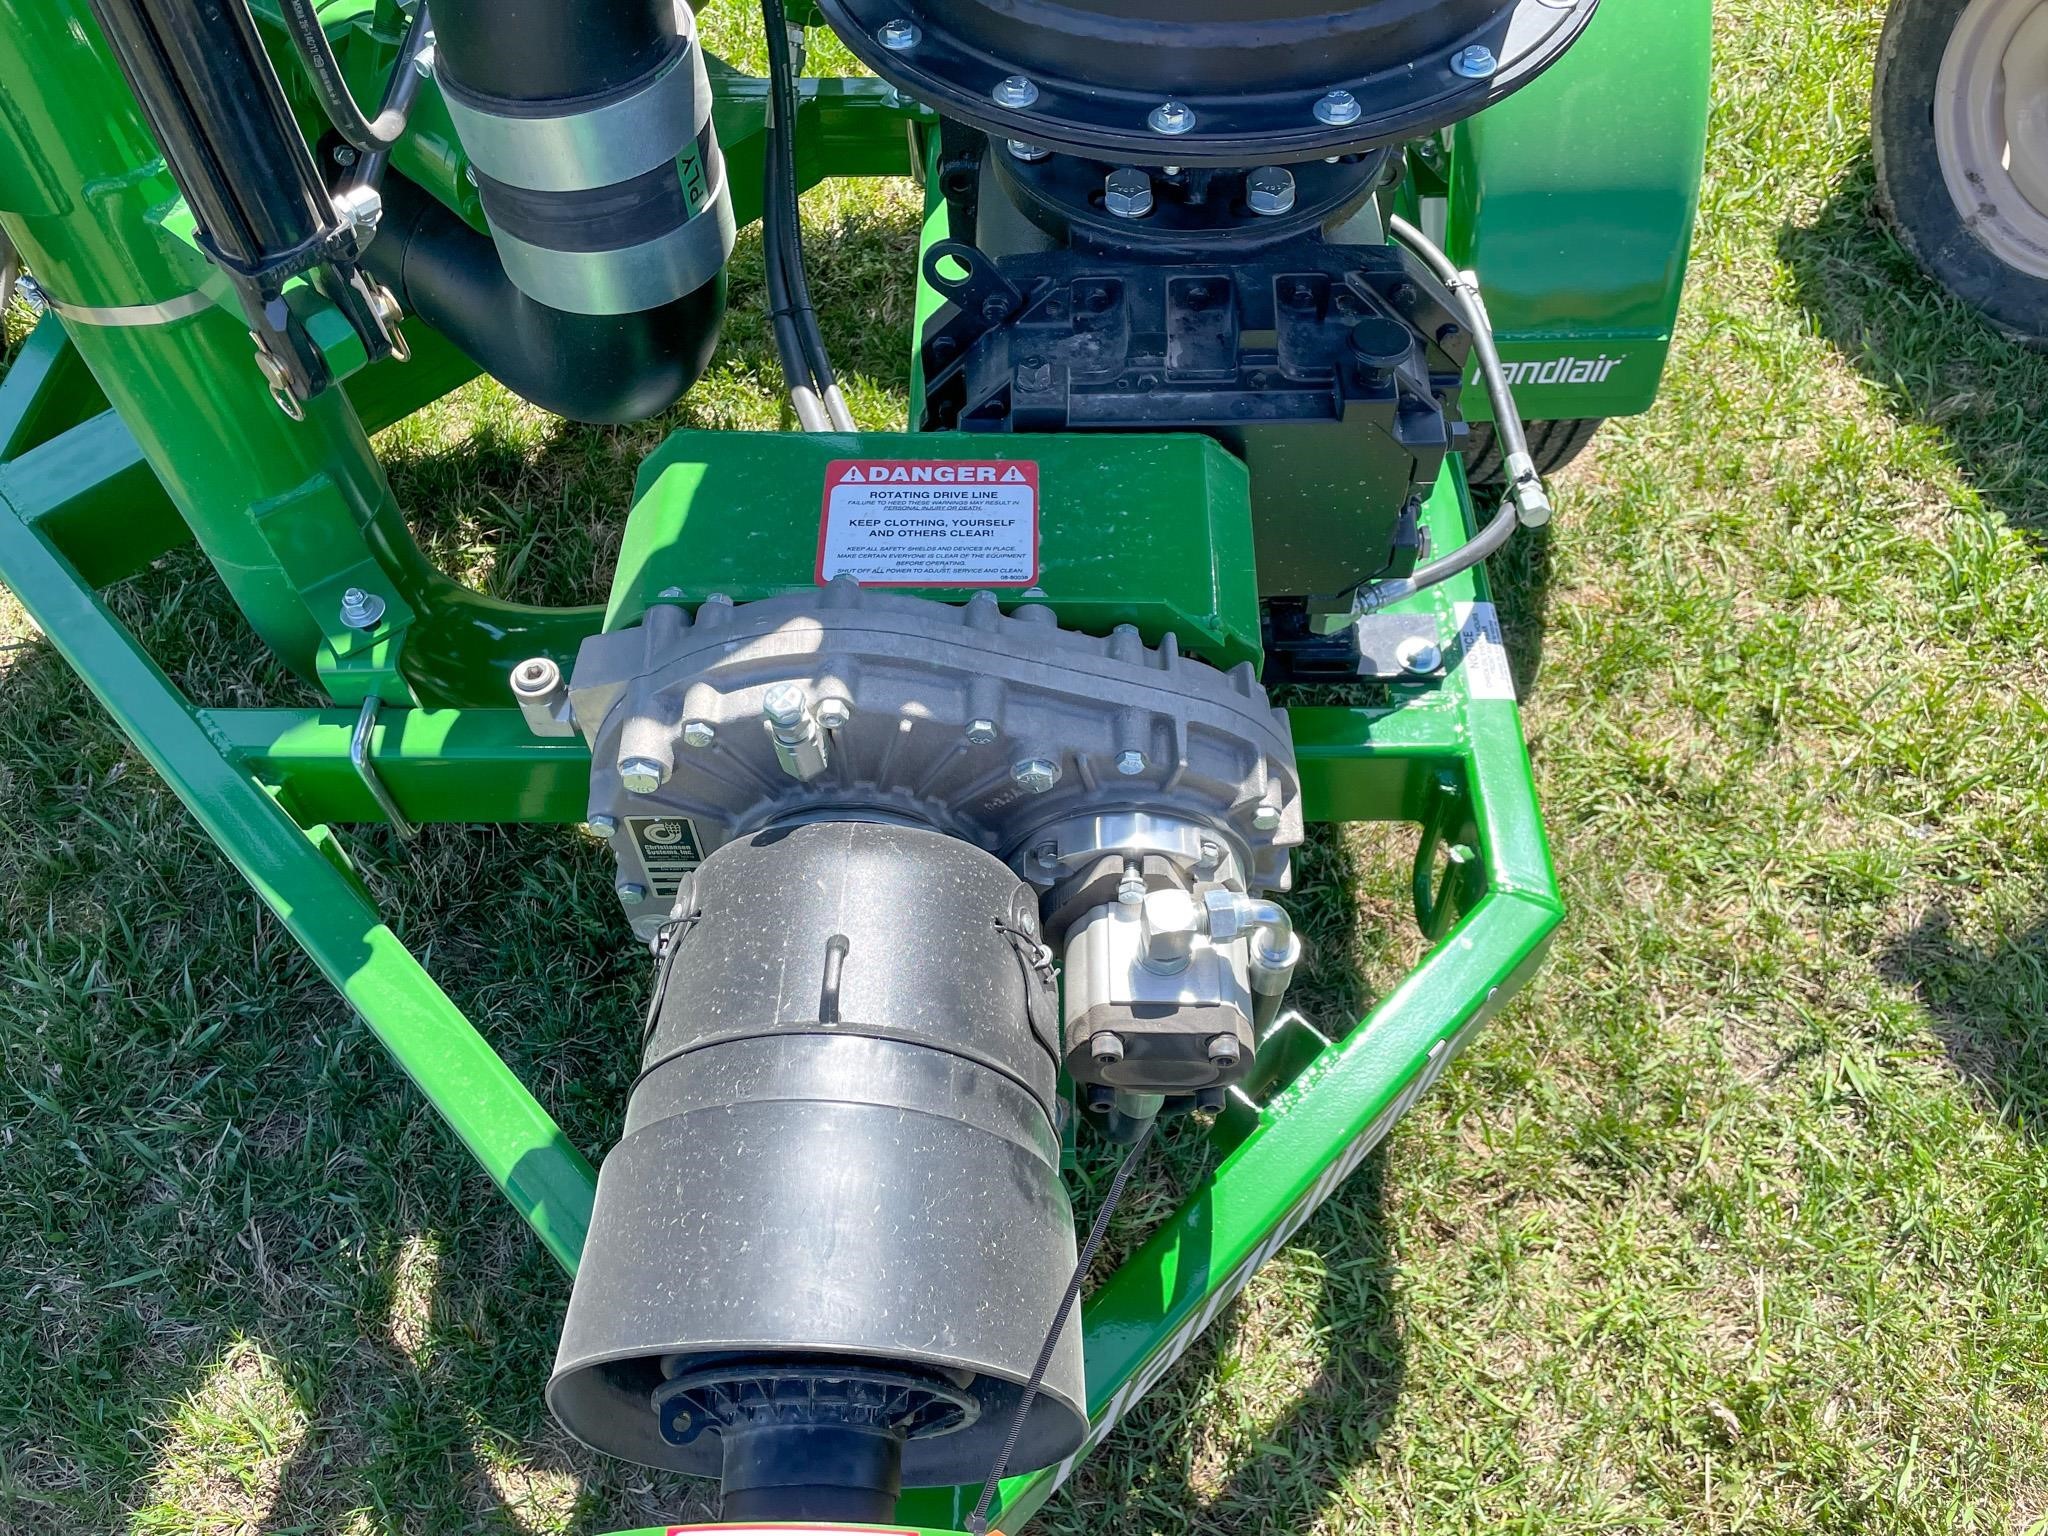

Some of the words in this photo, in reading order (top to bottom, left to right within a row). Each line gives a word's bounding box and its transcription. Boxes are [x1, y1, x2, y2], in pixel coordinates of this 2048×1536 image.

[681, 155, 704, 205] PLY
[1471, 353, 1622, 386] andlair
[868, 467, 996, 482] DANGER
[870, 491, 930, 499] ROTATING
[934, 491, 968, 499] DRIVE
[972, 491, 998, 499] LINE
[849, 519, 881, 527] KEEP
[884, 519, 948, 528] CLOTHING,
[952, 519, 1016, 527] YOURSELF
[869, 529, 894, 537] AND
[898, 529, 947, 537] OTHERS
[950, 529, 994, 537] CLEAR!
